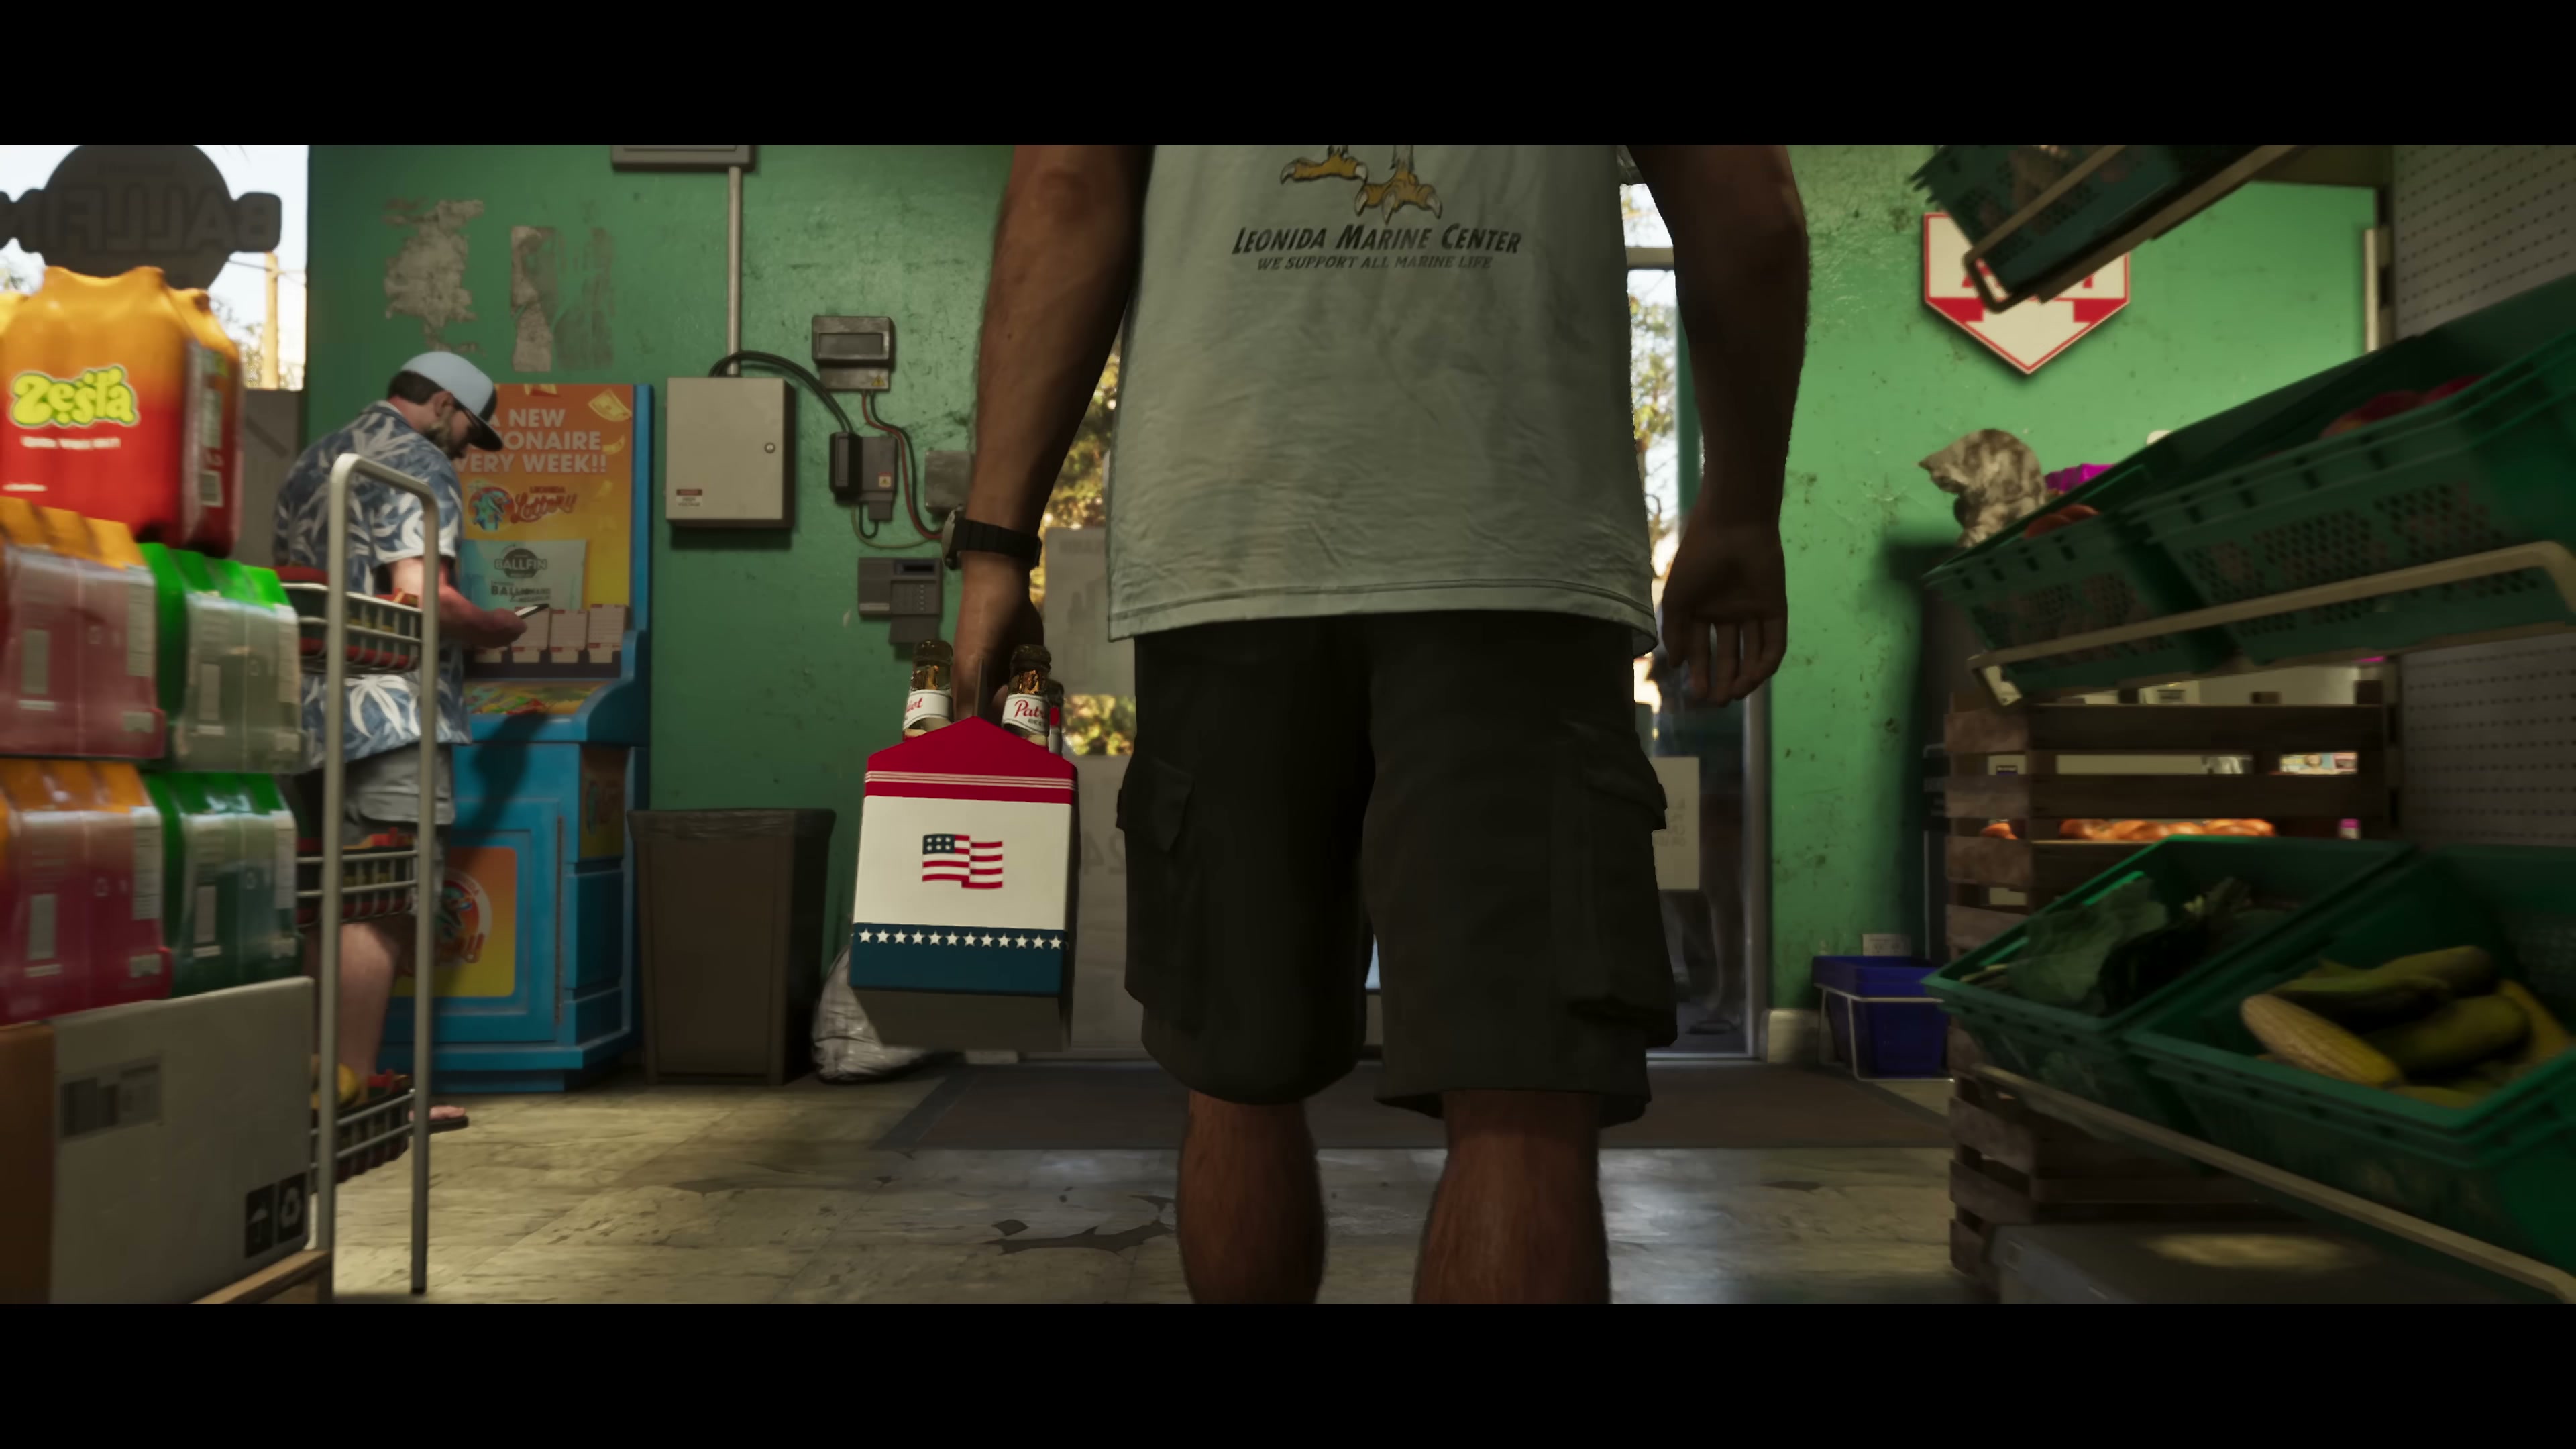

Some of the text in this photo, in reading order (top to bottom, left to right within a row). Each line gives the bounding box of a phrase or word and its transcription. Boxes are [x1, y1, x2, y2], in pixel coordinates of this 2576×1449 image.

[1232, 223, 1522, 255] LEONIDA MARINE CENTER
[1257, 255, 1493, 270] WE SUPPORT ALL MARINE LIFE
[508, 408, 566, 427] NEW
[498, 431, 602, 451] ONAIRE
[453, 453, 607, 473] VERY WEEK!!
[495, 558, 548, 570] BALLFIN
